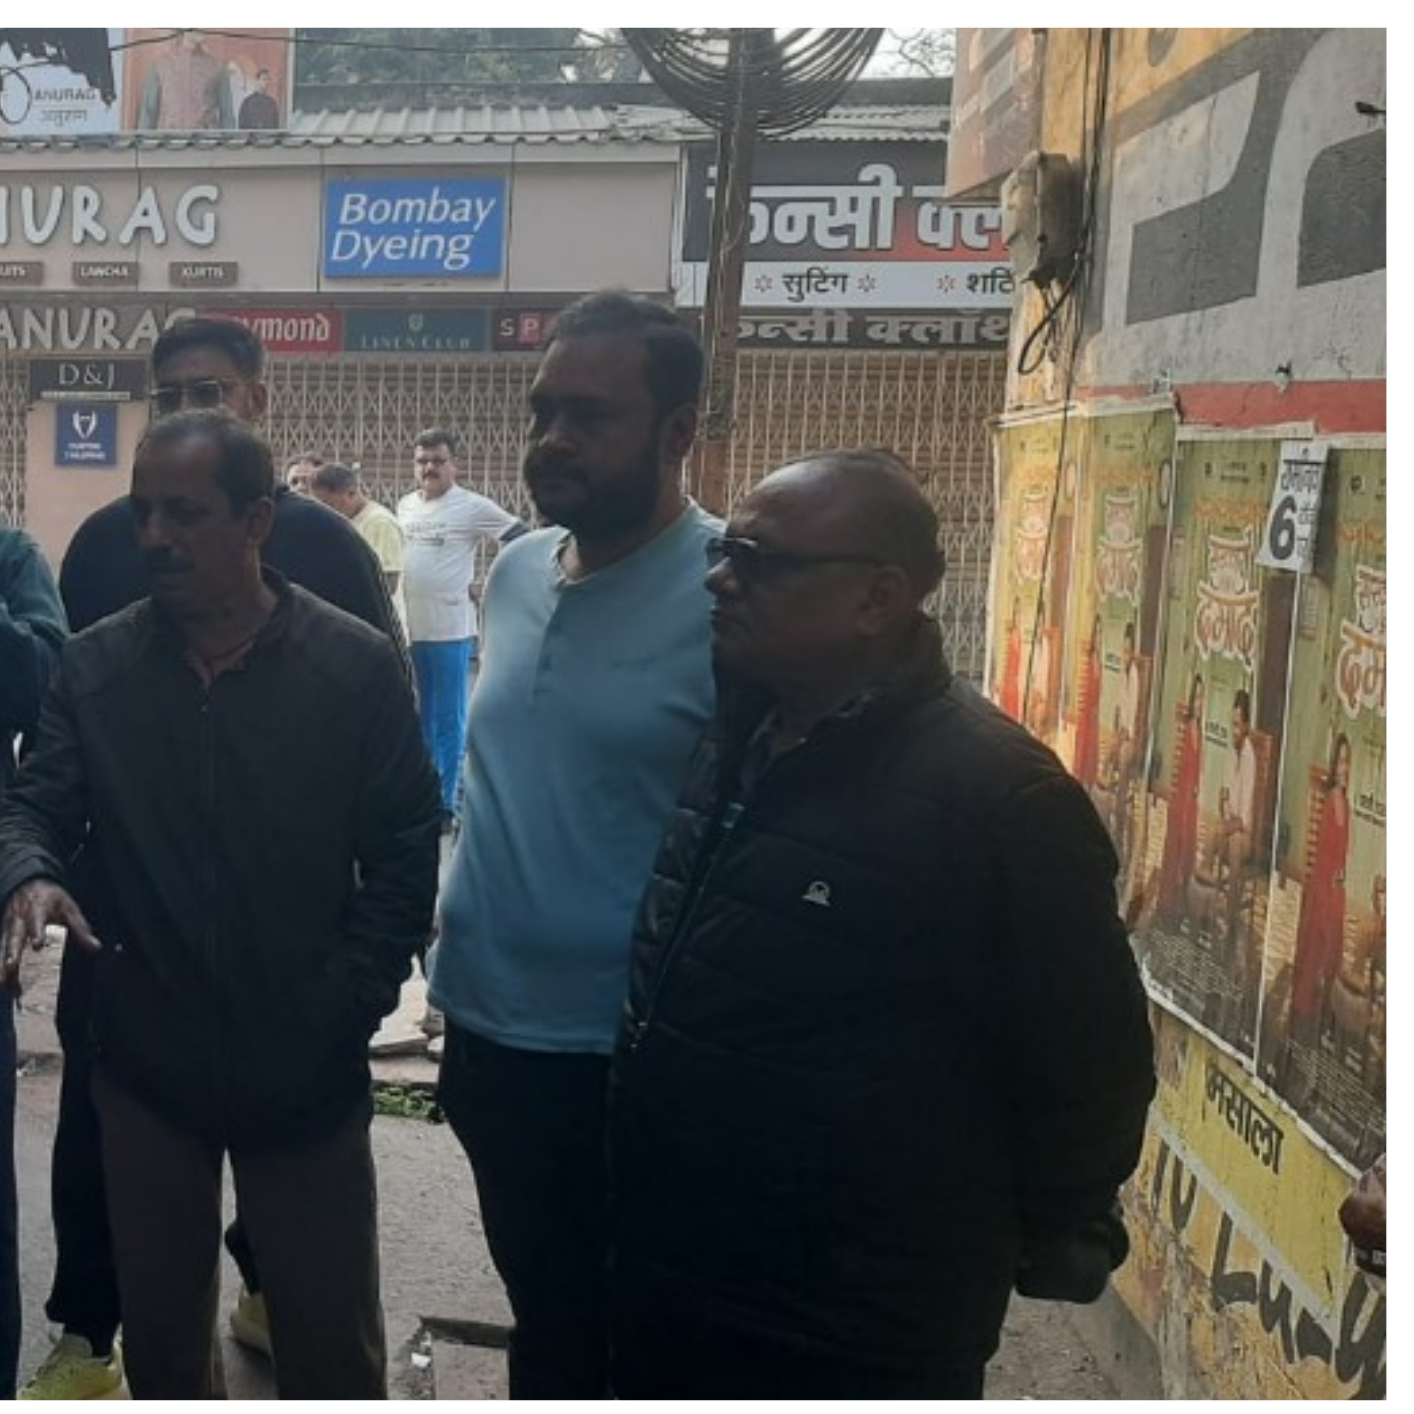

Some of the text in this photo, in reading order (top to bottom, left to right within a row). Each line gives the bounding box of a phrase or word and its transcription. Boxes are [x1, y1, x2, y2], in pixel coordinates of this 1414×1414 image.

[339, 186, 496, 234] Bombay
[332, 230, 475, 267] Dyeing
[238, 312, 329, 341] ymond
[59, 363, 115, 390] D&J
[1270, 495, 1296, 561] 6
